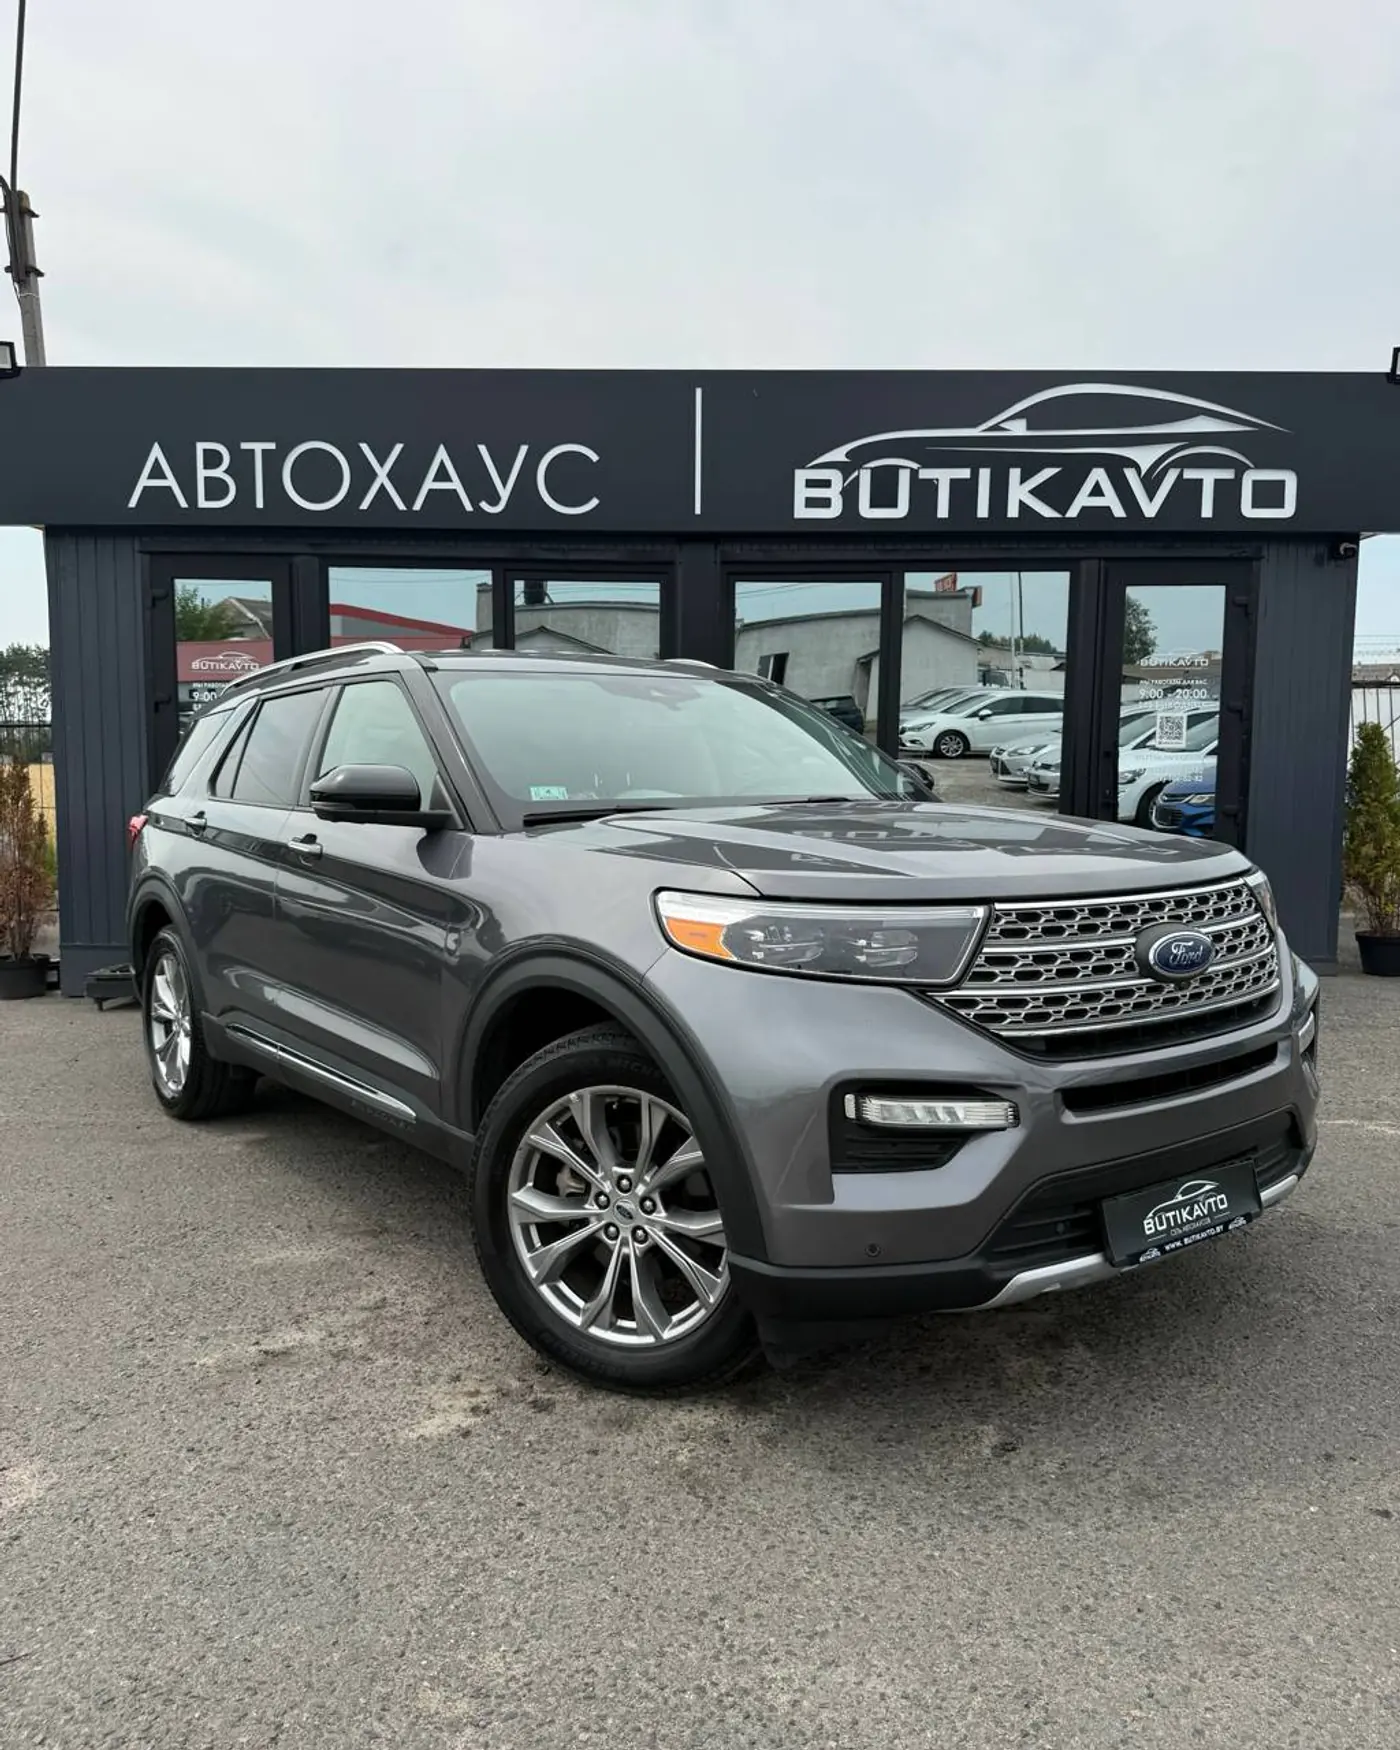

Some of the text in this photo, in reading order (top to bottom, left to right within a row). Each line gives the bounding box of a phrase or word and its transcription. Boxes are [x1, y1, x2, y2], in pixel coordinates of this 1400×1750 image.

[127, 440, 600, 515] АВТОХАУС
[793, 466, 1298, 519] BUTIKAVTO
[191, 660, 260, 670] BUTIKAVTO
[1139, 659, 1209, 667] BUTIKAVTO
[1139, 689, 1164, 699] 9:00
[1175, 688, 1207, 699] 20:00
[1169, 941, 1203, 965] Ford
[1143, 1194, 1229, 1235] BUTIKAVTO
